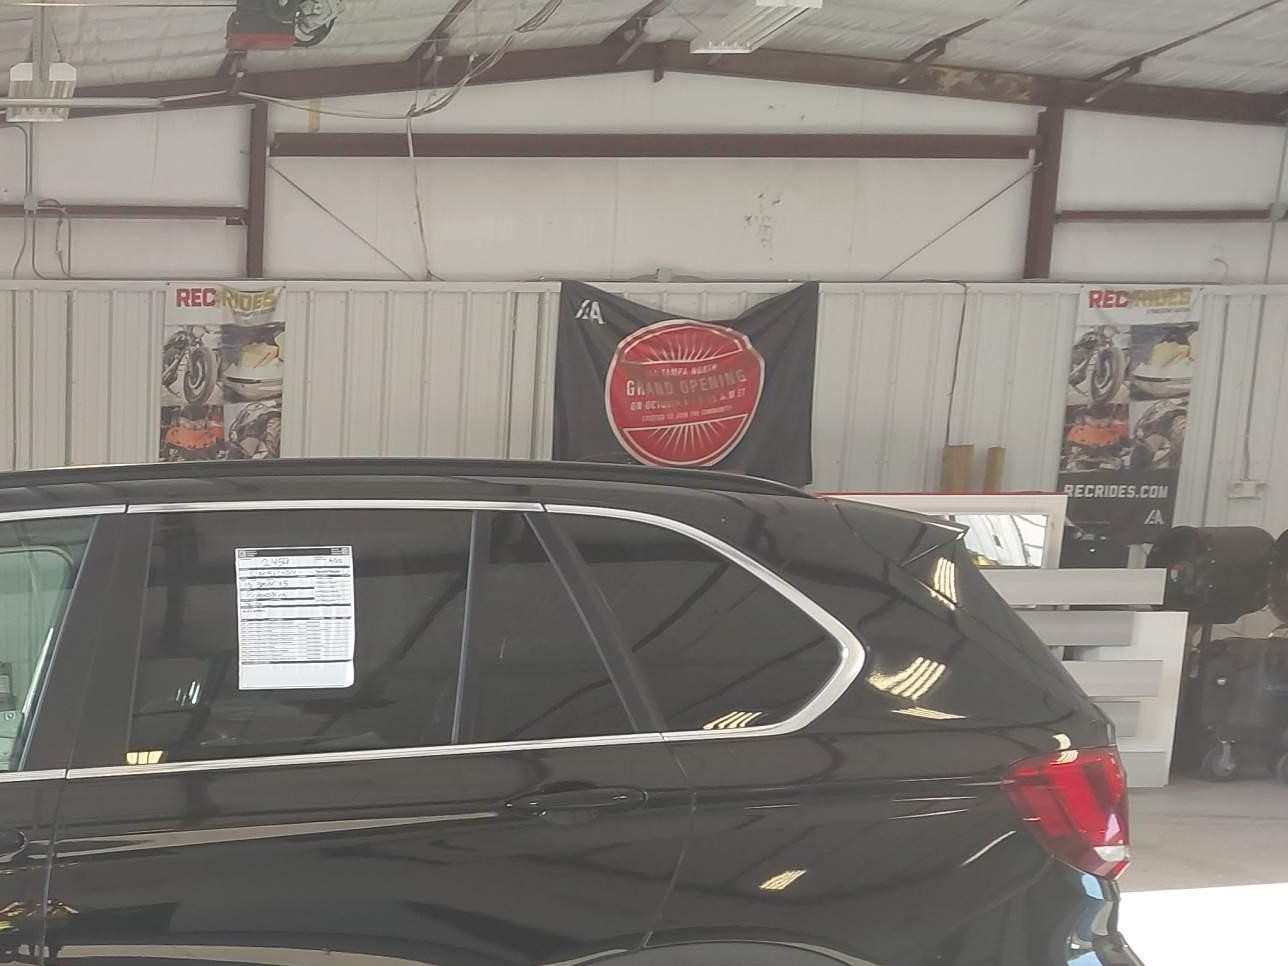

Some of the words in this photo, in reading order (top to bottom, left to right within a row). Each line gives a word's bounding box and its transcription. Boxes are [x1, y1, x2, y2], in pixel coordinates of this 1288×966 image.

[176, 288, 217, 308] REC
[221, 287, 276, 311] RIDES
[1089, 289, 1129, 308] REC
[1134, 288, 1192, 308] RIDES
[626, 379, 673, 397] GRAND
[679, 369, 748, 394] OPENING
[1063, 484, 1169, 498] RECRIDES.COM
